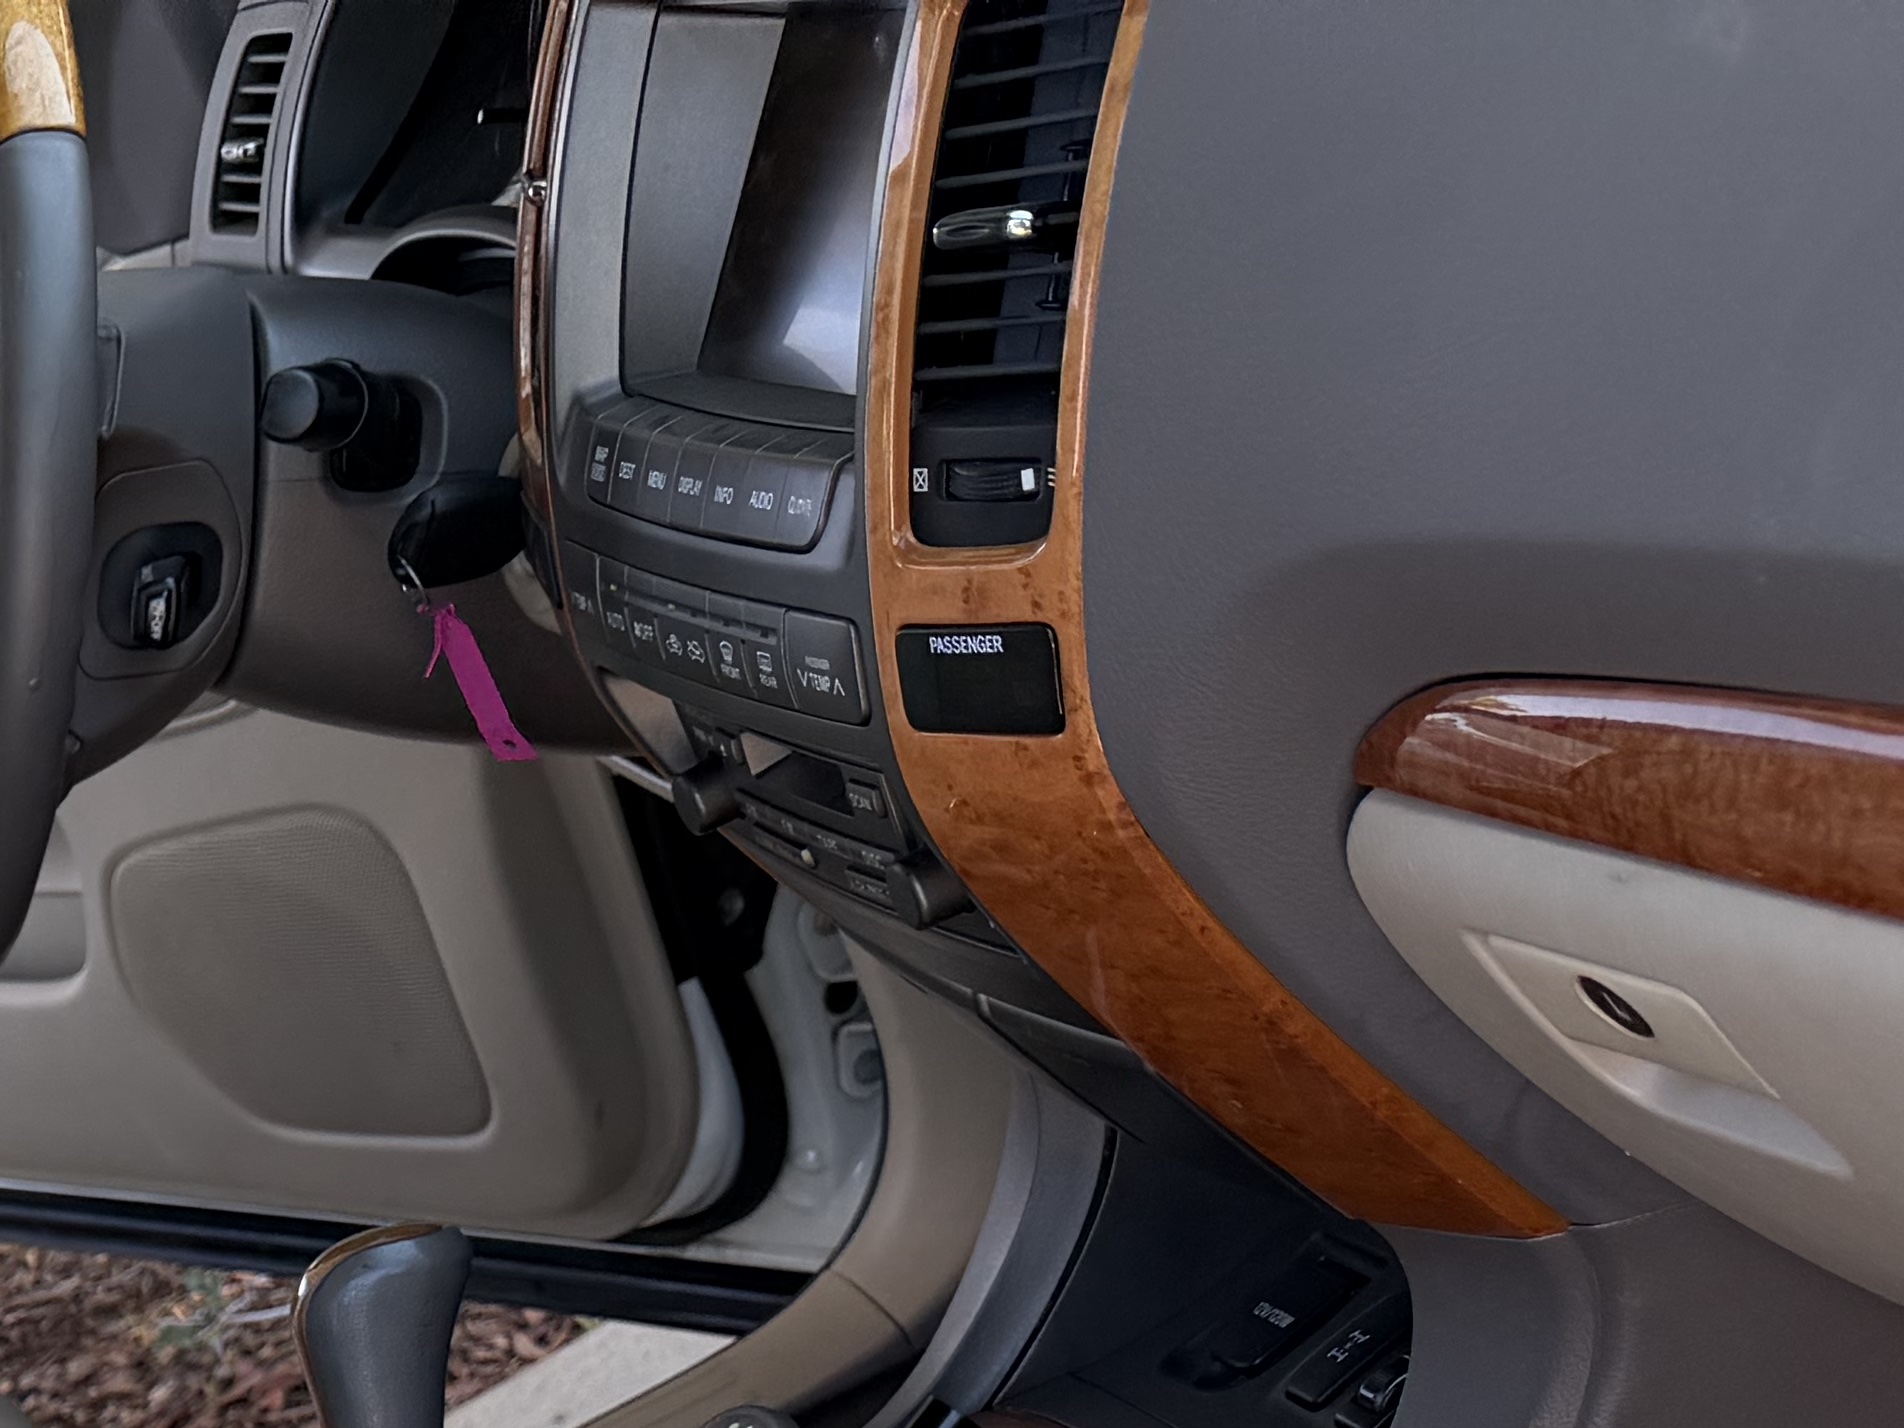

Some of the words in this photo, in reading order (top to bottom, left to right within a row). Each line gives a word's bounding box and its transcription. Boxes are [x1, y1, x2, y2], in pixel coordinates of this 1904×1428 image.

[647, 469, 667, 490] MENU
[678, 475, 703, 497] DISPLAY
[714, 484, 734, 505] INFO
[748, 489, 774, 510] AUDIO
[928, 635, 1004, 654] PASSENGER
